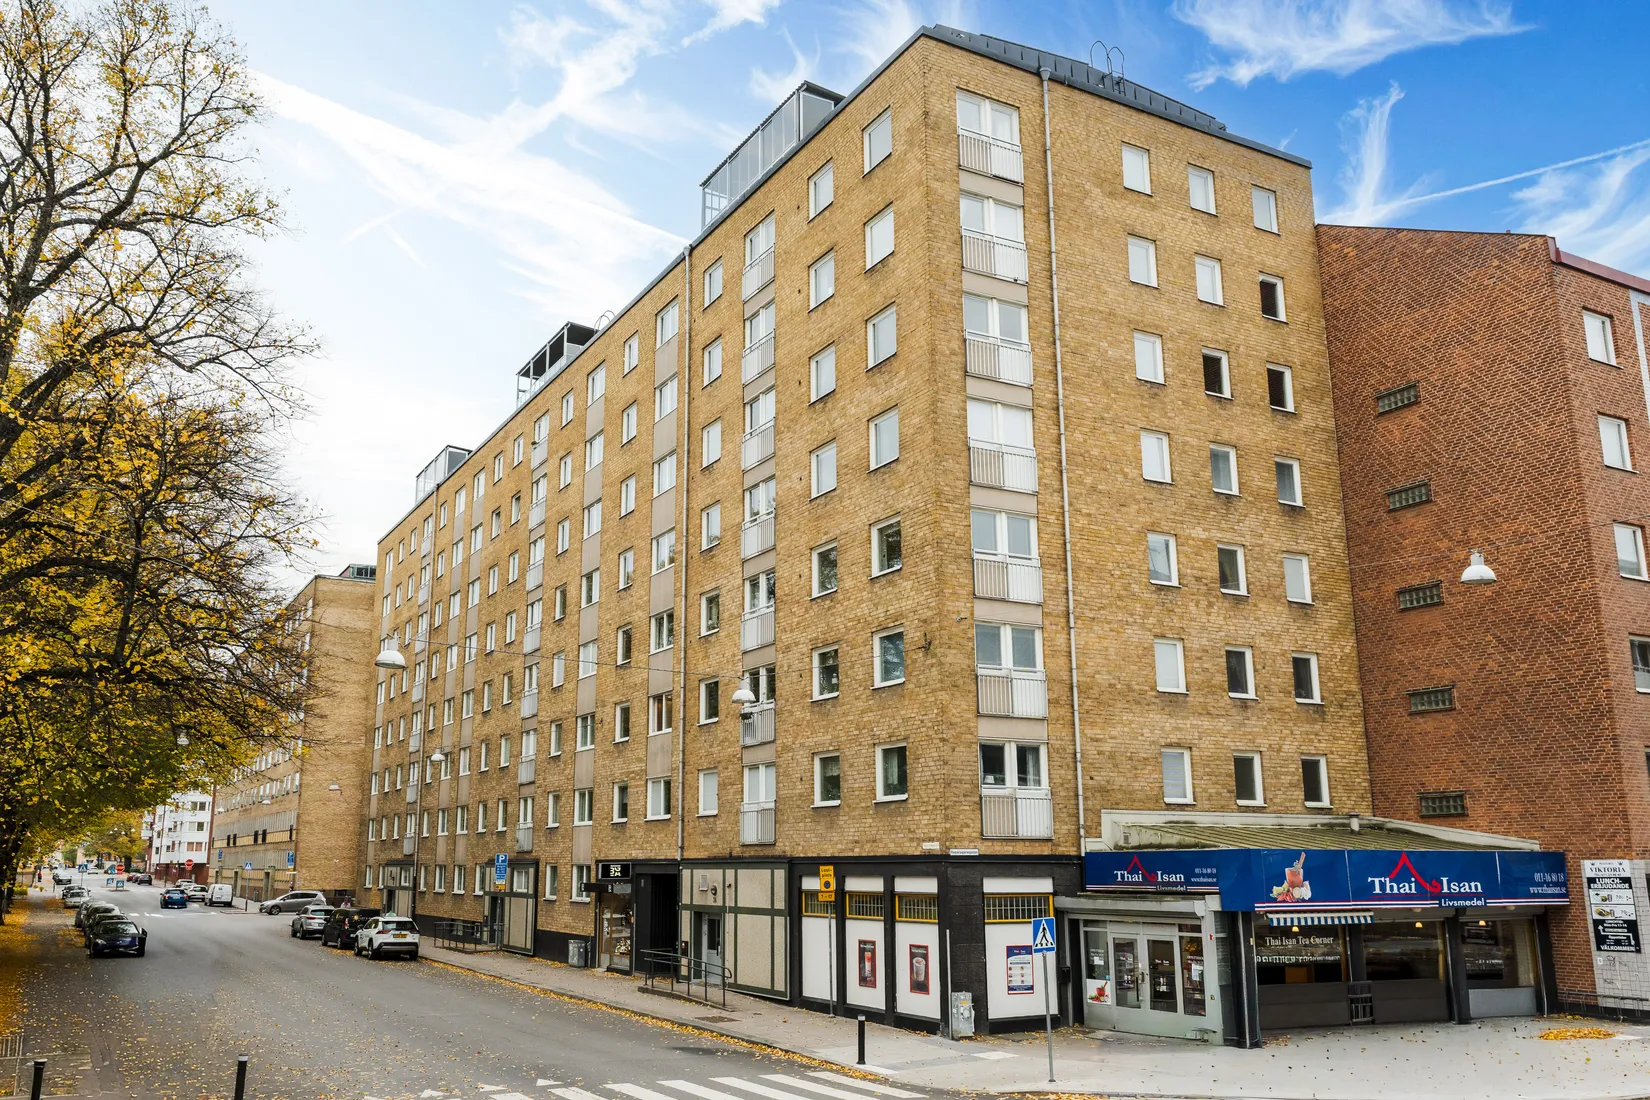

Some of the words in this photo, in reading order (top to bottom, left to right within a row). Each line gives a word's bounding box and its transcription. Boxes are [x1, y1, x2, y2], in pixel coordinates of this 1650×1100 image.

[499, 855, 506, 863] P
[1114, 871, 1143, 882] Thai
[1156, 871, 1185, 882] Isan
[1367, 877, 1417, 894] Thai
[1440, 877, 1483, 893] Isan
[1441, 897, 1485, 907] Livsmedel
[1265, 936, 1281, 945] Thai
[1282, 936, 1297, 945] Isan
[1297, 936, 1310, 944] Tea
[1310, 935, 1334, 944] Corner
